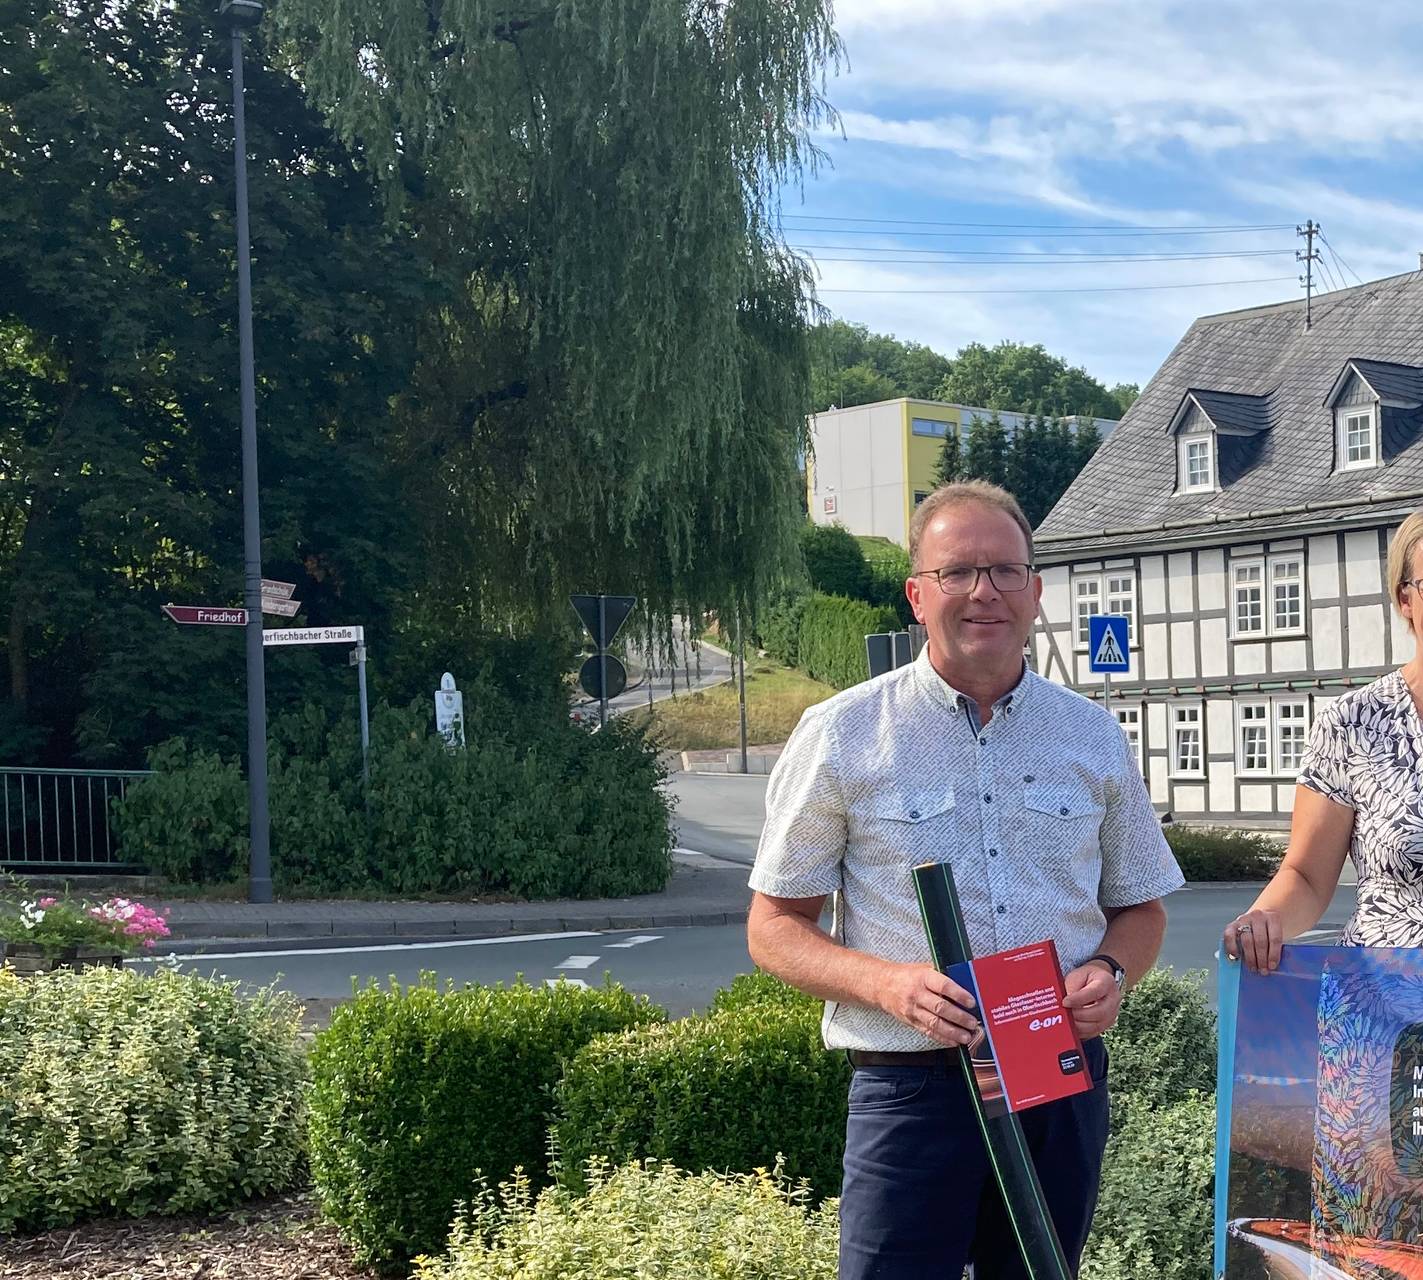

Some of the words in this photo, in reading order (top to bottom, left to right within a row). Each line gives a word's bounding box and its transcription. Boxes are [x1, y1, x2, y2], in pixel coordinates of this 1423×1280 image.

[197, 610, 243, 623] Friedhof
[262, 628, 322, 643] erfischbacher
[324, 629, 353, 640] Straße
